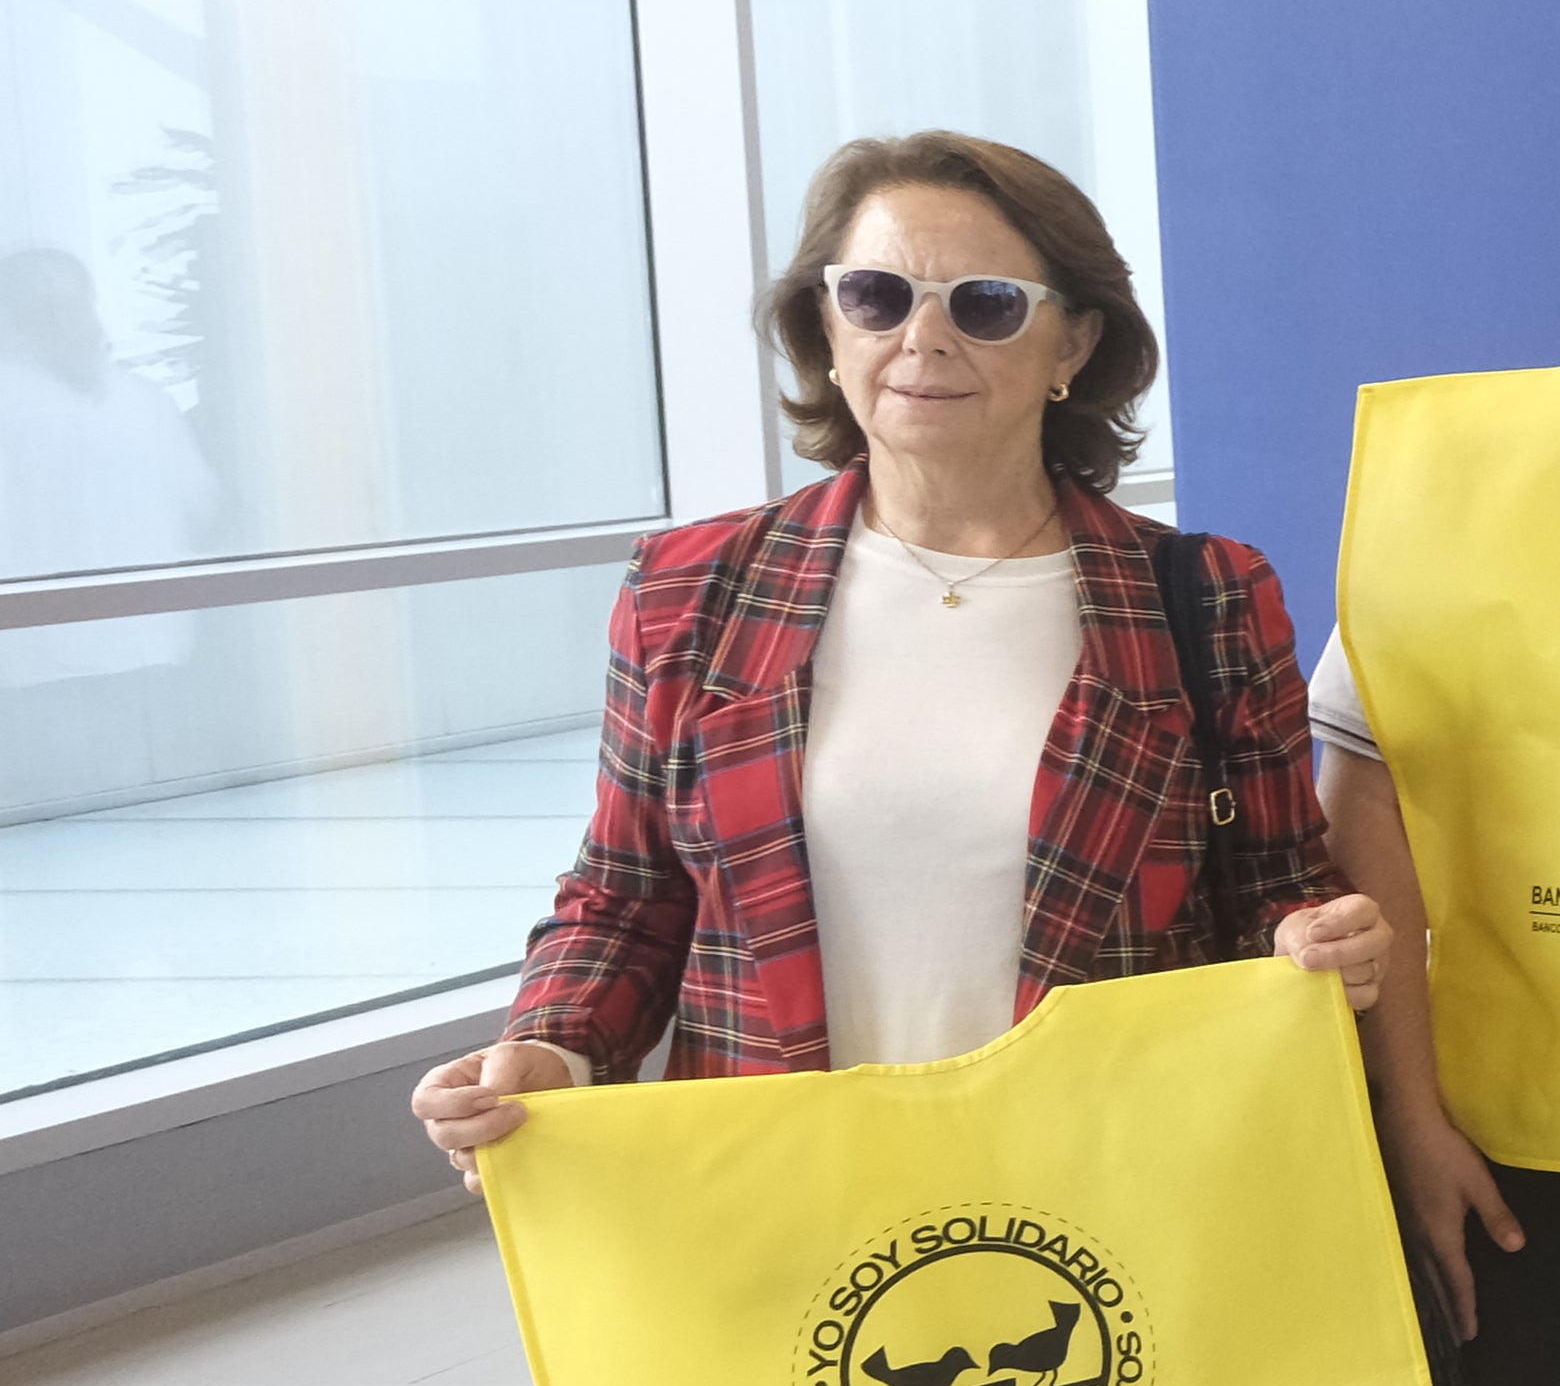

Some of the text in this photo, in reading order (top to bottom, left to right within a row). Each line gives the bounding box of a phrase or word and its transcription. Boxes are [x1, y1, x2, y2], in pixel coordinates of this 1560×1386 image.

[806, 1215, 1124, 1377] YO SOY SOLIDARIO
